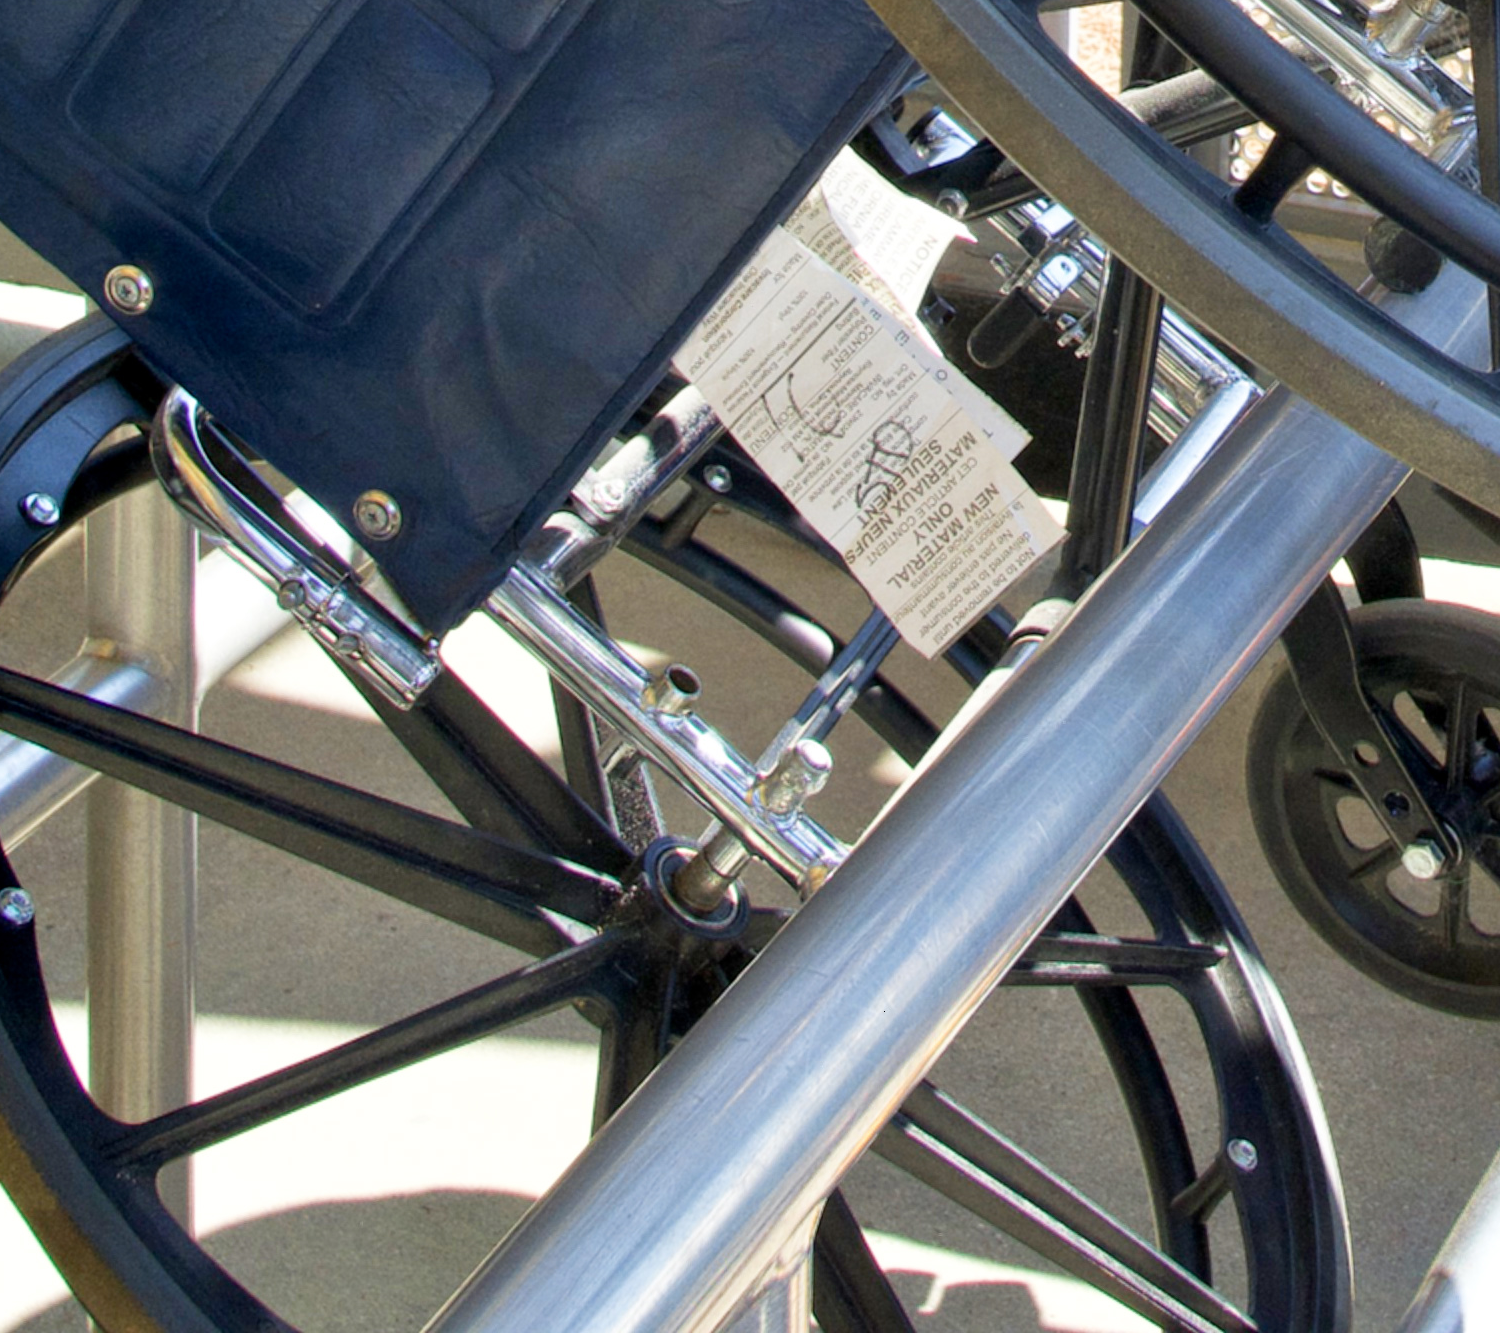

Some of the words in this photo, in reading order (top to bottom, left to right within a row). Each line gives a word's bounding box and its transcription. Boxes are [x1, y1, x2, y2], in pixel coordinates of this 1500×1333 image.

[716, 279, 745, 314] Invacare
[740, 265, 772, 303] Invacare
[701, 296, 743, 347] Corporation
[829, 322, 874, 372] CONTENT
[853, 437, 944, 530] SEULEMENT
[890, 429, 979, 520] MATÉRIAUX
[954, 454, 978, 479] CET
[913, 473, 959, 519] ARTICLE
[960, 482, 1000, 522] NEW
[1011, 500, 1024, 512] la
[908, 499, 955, 546] ONLY
[973, 507, 995, 529] This
[974, 508, 1014, 547] livraison
[840, 512, 894, 567] NEUFS
[863, 512, 917, 567] CONTIENT
[885, 515, 964, 593] MATERIAL
[946, 525, 976, 555] article
[961, 543, 976, 558] au
[977, 541, 998, 562] pas
[987, 530, 1032, 573] delivered
[995, 528, 1013, 547] Ne
[909, 551, 949, 590] contains
[1004, 562, 1019, 577] to
[1014, 546, 1036, 568] Not
[944, 559, 981, 595] enlever
[961, 578, 980, 597] the
[976, 569, 990, 583] to
[990, 573, 1008, 590] be
[916, 592, 964, 638] consumer
[918, 590, 948, 618] avant
[951, 584, 995, 626] removed
[931, 621, 955, 645] until
